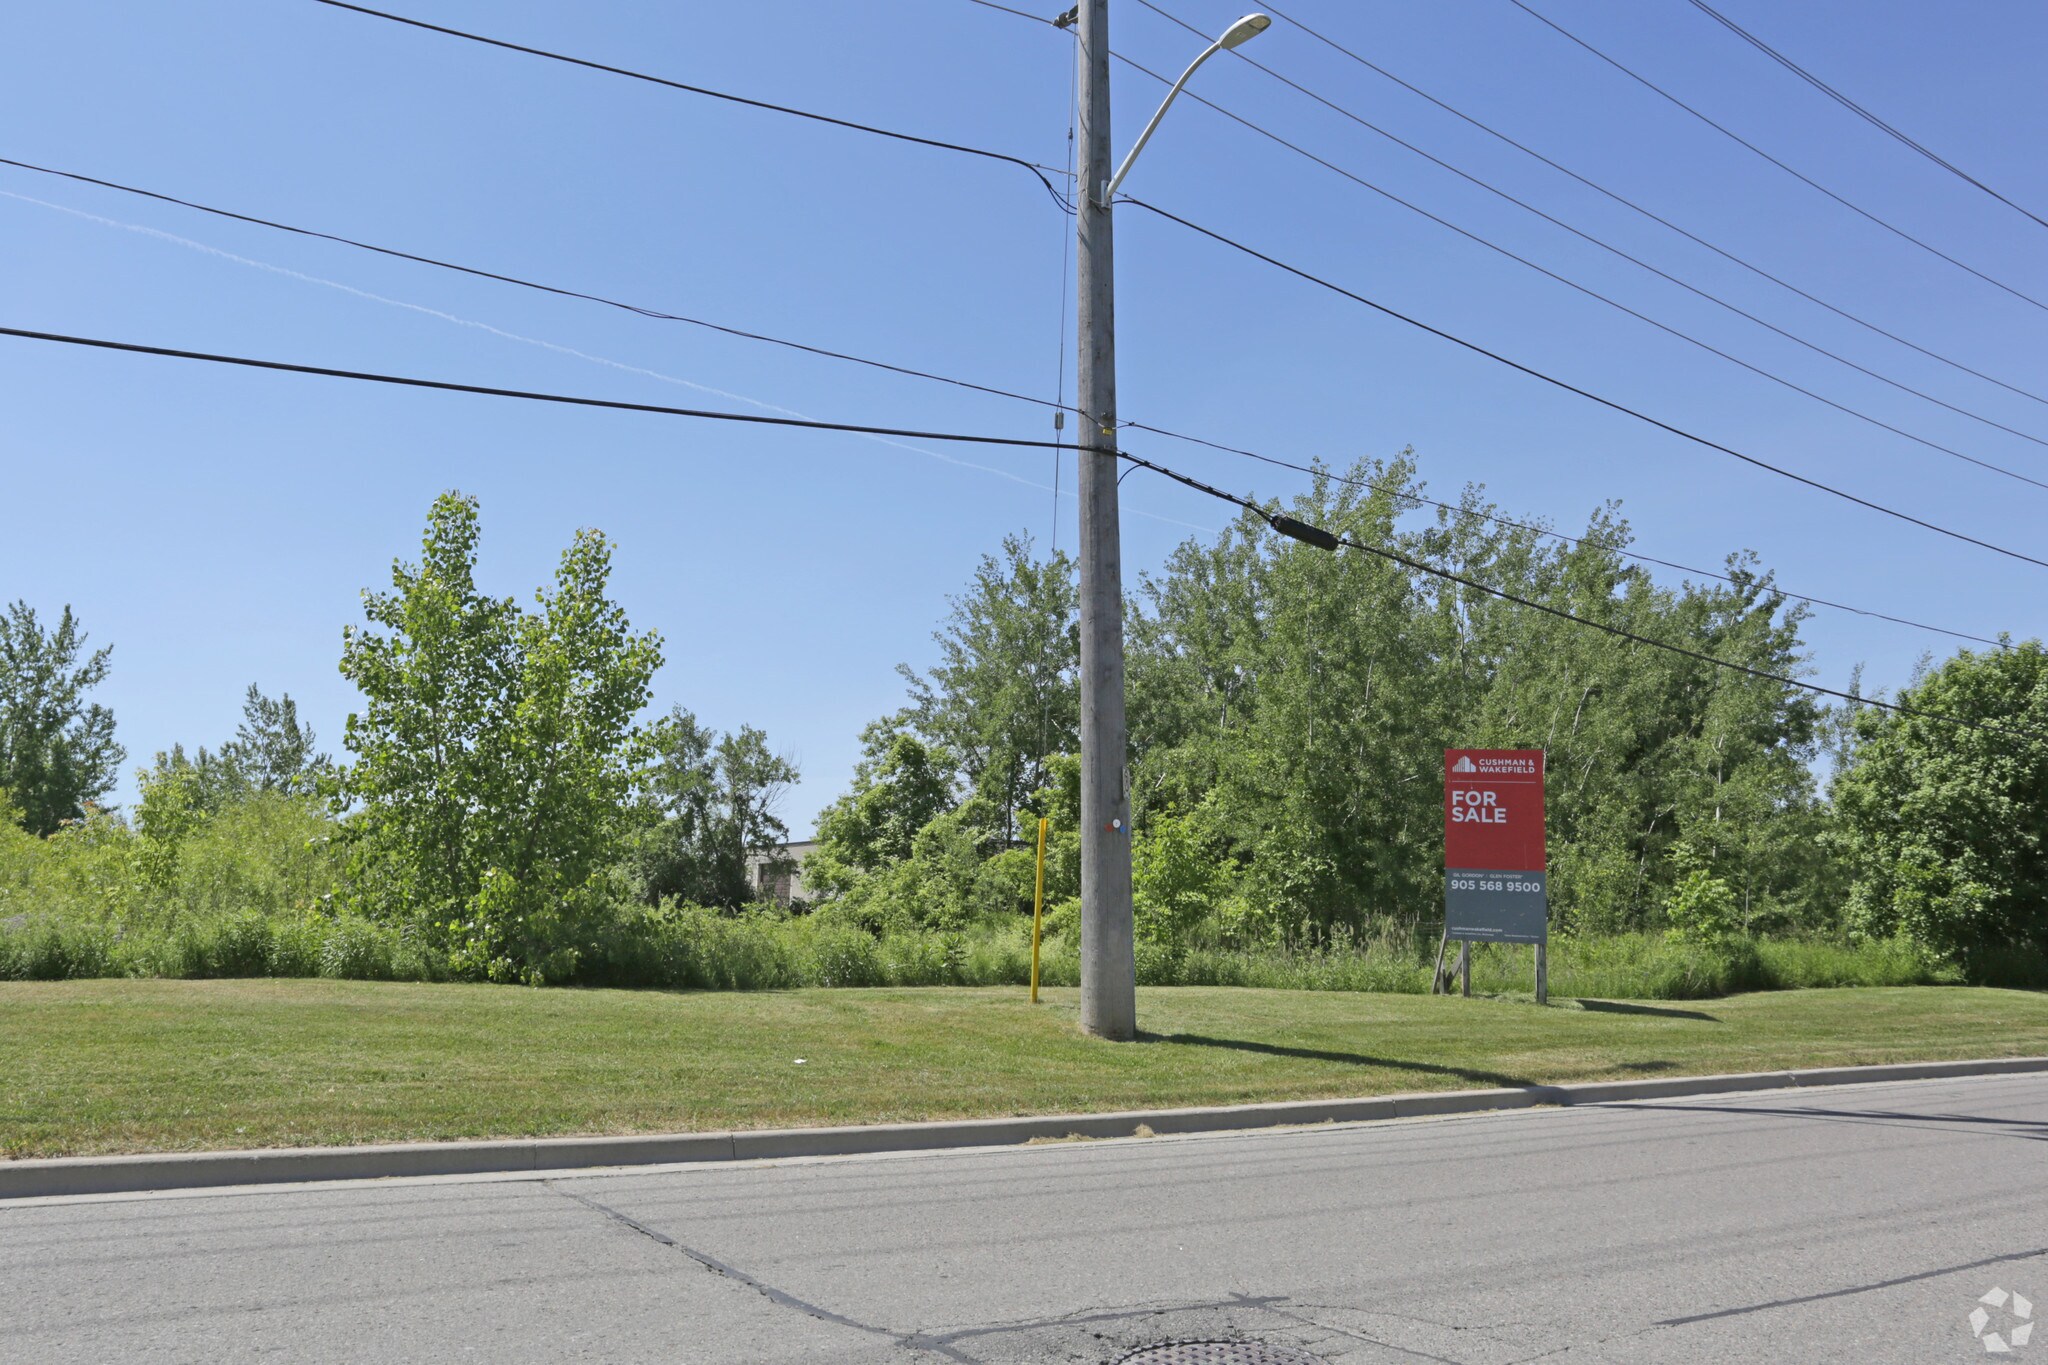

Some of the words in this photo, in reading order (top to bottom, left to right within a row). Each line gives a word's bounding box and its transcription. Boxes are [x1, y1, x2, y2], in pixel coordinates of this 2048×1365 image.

[1452, 790, 1497, 807] FOR
[1452, 807, 1507, 824] SALE
[1451, 880, 1475, 890] 905
[1479, 881, 1503, 891] 568
[1506, 882, 1540, 892] 9500
